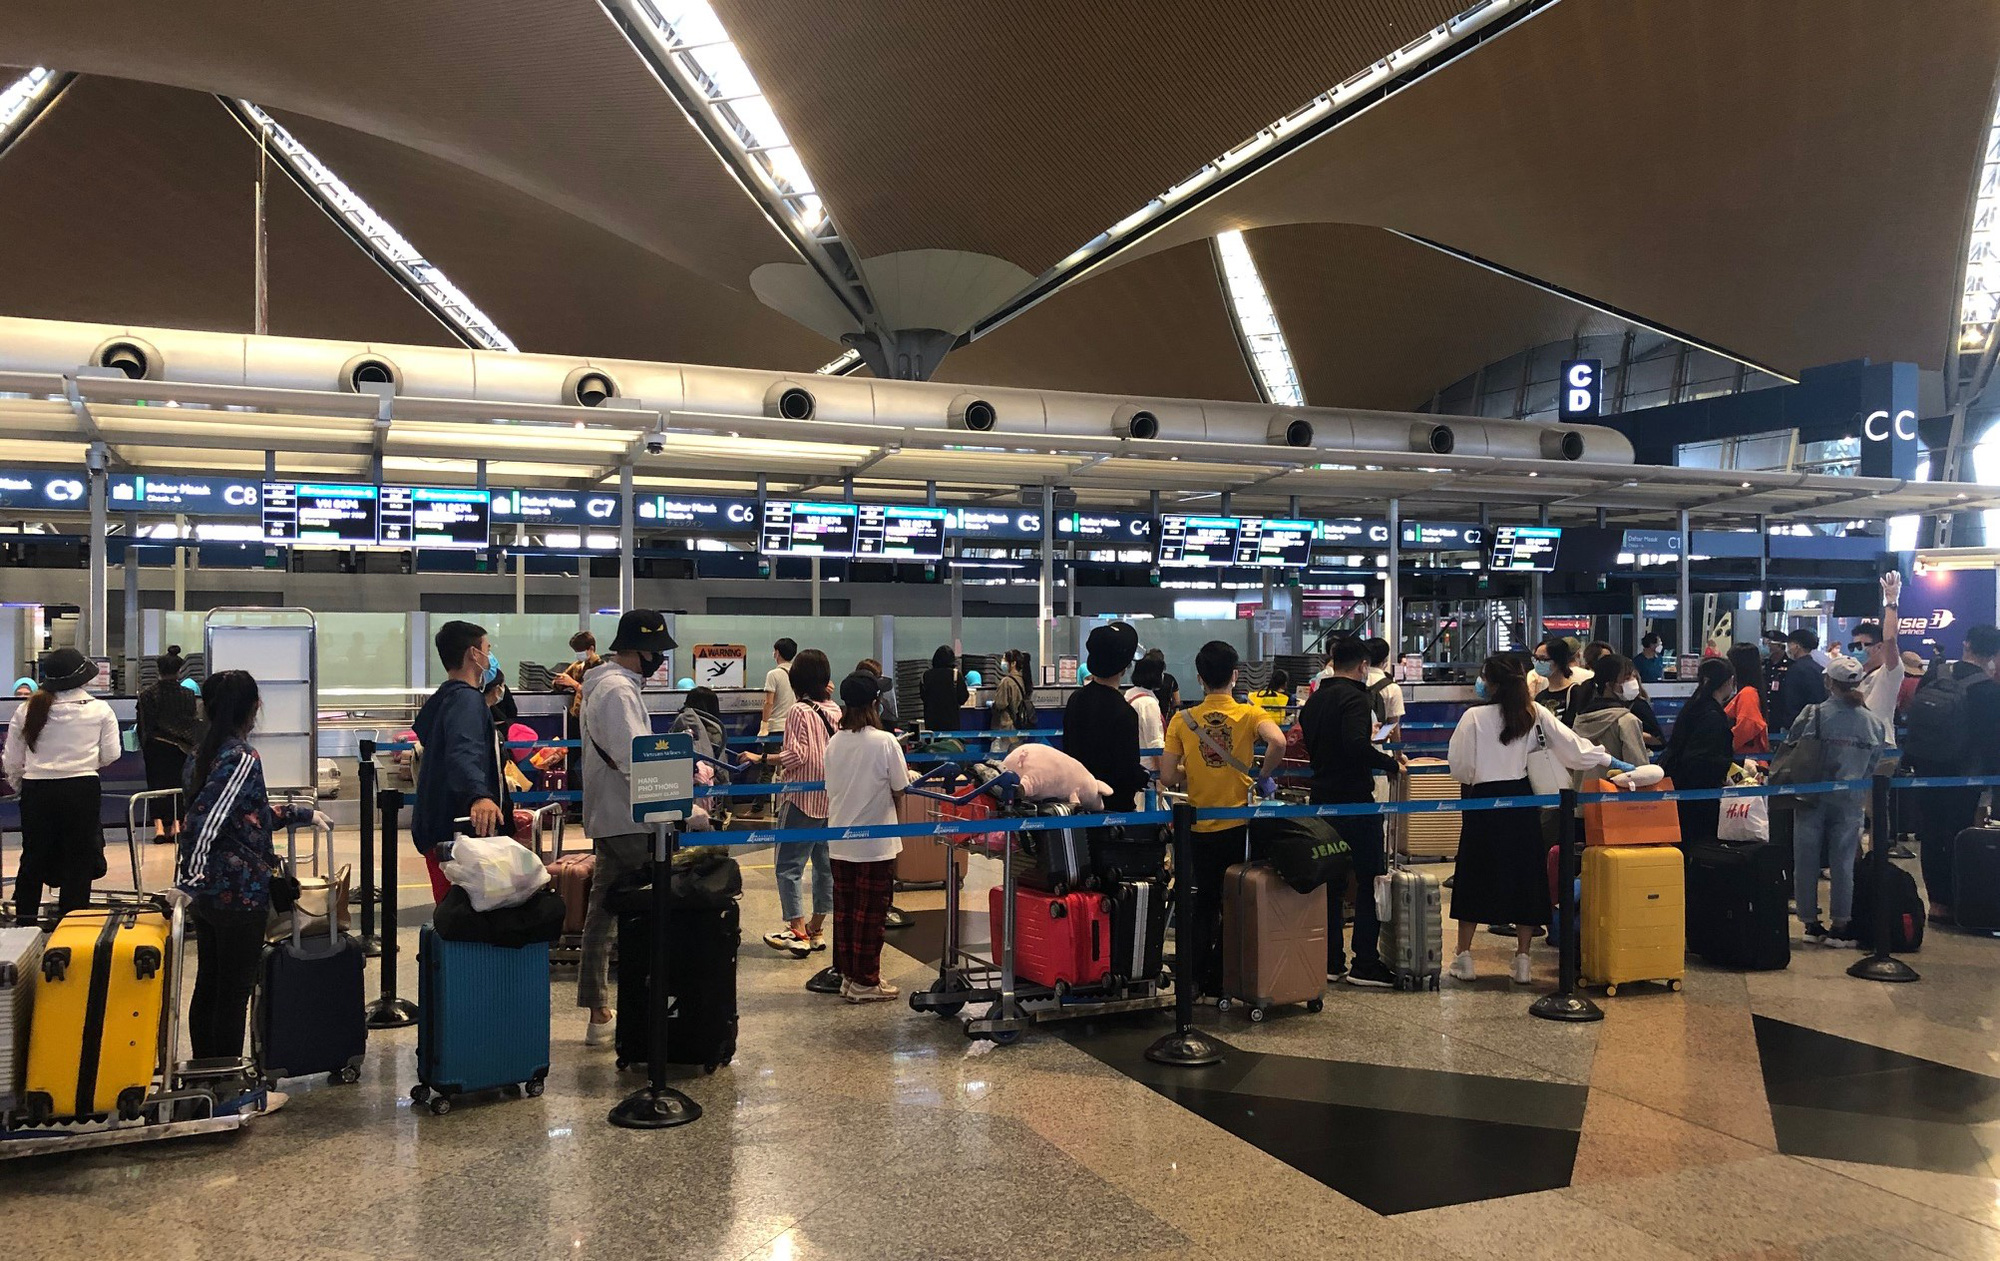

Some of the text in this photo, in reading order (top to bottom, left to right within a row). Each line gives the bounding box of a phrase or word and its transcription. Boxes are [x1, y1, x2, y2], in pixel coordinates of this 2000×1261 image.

[1569, 364, 1592, 388] C
[1569, 389, 1591, 412] D
[1865, 410, 1888, 442] C
[1897, 410, 1915, 441] C
[47, 480, 83, 501] C9
[225, 486, 257, 505] C8
[587, 499, 616, 518] C7
[728, 504, 754, 523] C6
[1018, 515, 1040, 531] C5
[1130, 520, 1150, 536] C4
[1369, 526, 1388, 541] C3
[1464, 530, 1482, 544] C2
[1668, 537, 1681, 549] C1
[708, 648, 741, 657] WARNING
[1726, 803, 1751, 819] H&M
[1311, 840, 1351, 860] JEALO
